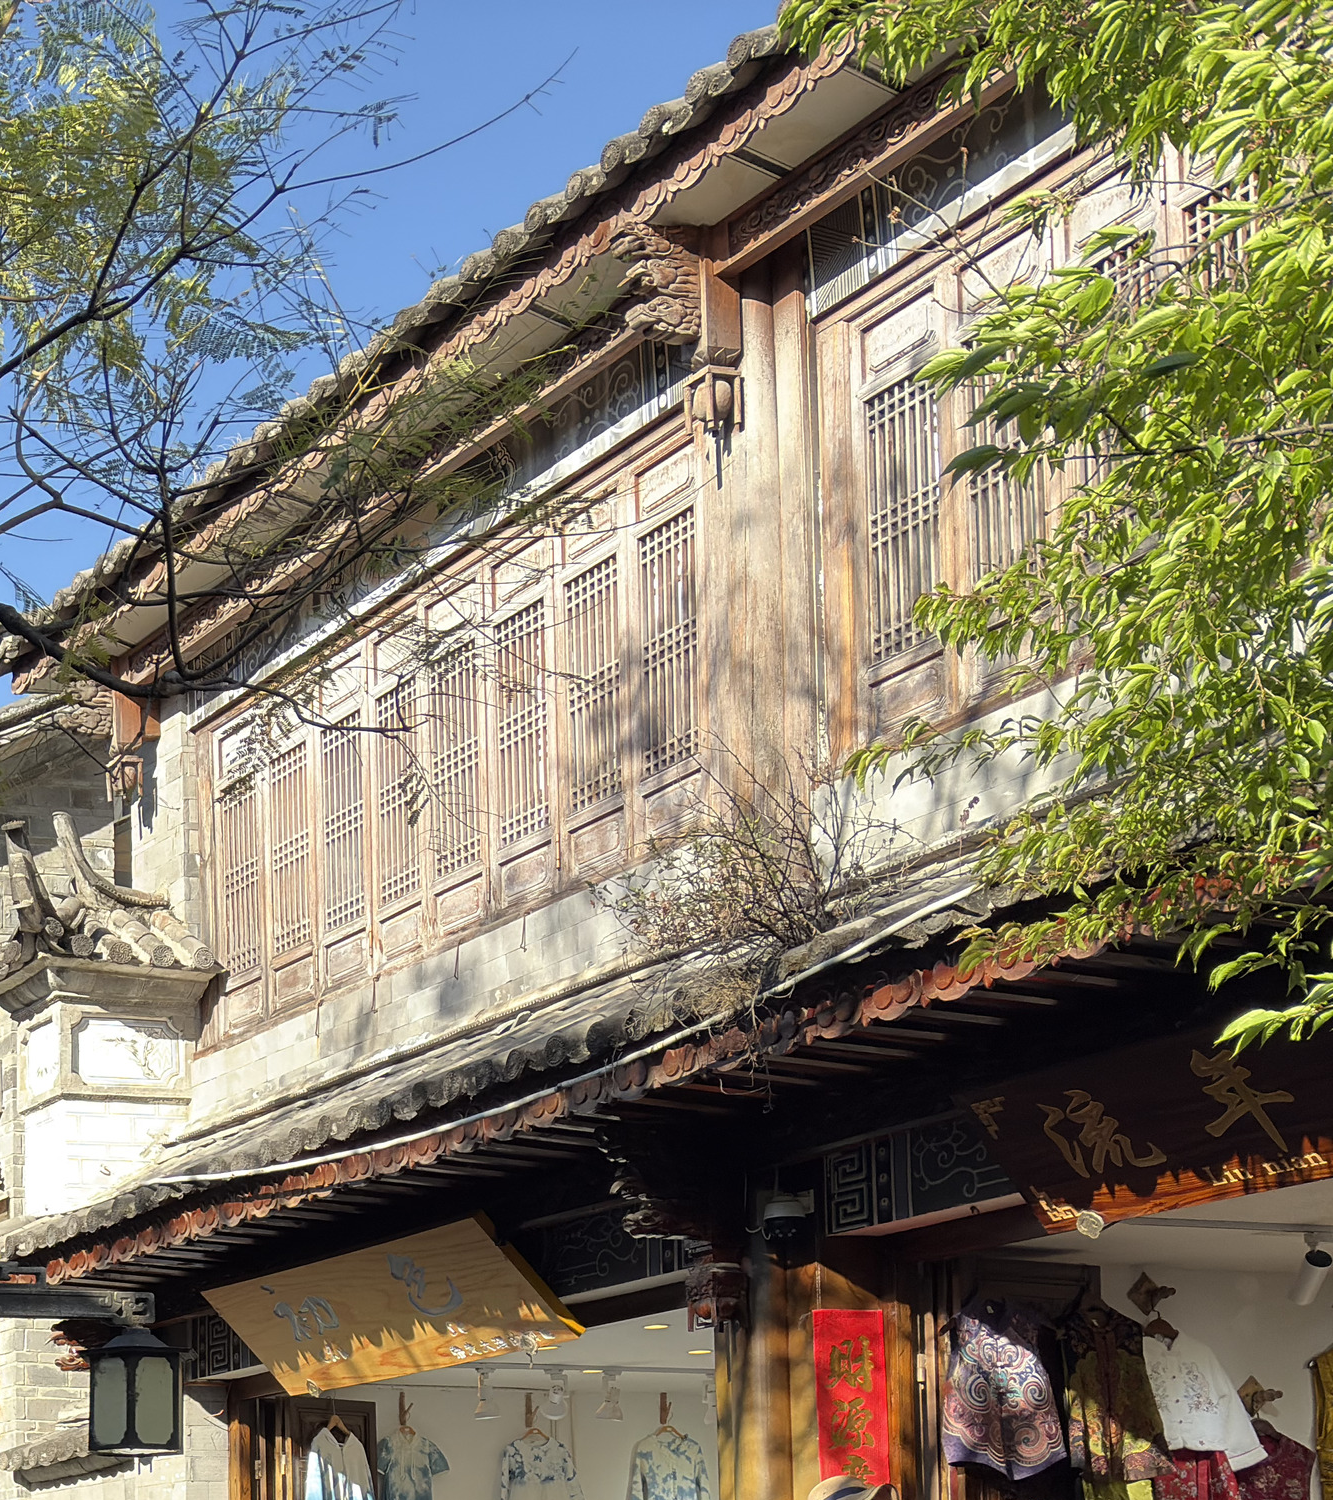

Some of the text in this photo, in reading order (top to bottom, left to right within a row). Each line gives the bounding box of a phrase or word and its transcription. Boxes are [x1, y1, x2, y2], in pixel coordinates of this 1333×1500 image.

[1036, 1049, 1296, 1178] 流年
[1203, 1150, 1328, 1186] Liu nian
